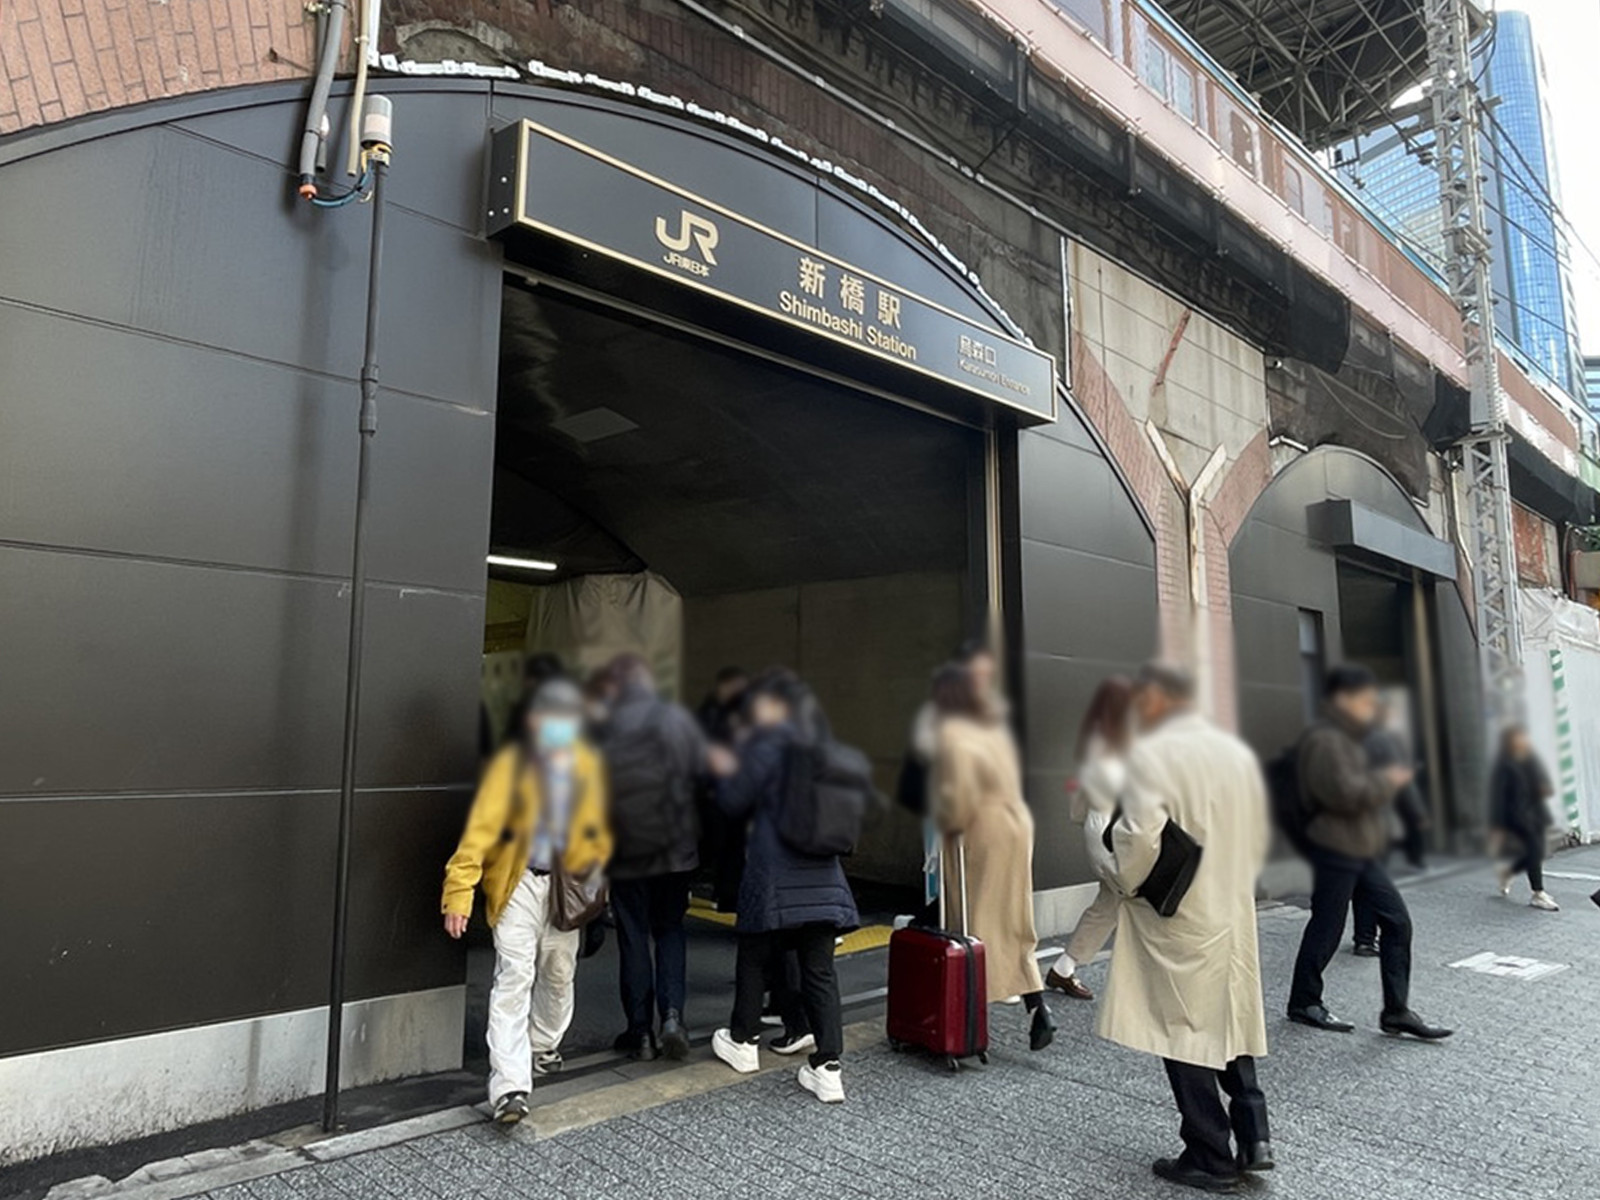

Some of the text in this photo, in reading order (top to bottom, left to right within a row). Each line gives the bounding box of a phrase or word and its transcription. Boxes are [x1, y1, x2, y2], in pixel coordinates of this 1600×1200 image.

[656, 209, 718, 266] JR
[779, 290, 917, 360] Shimbashi Station
